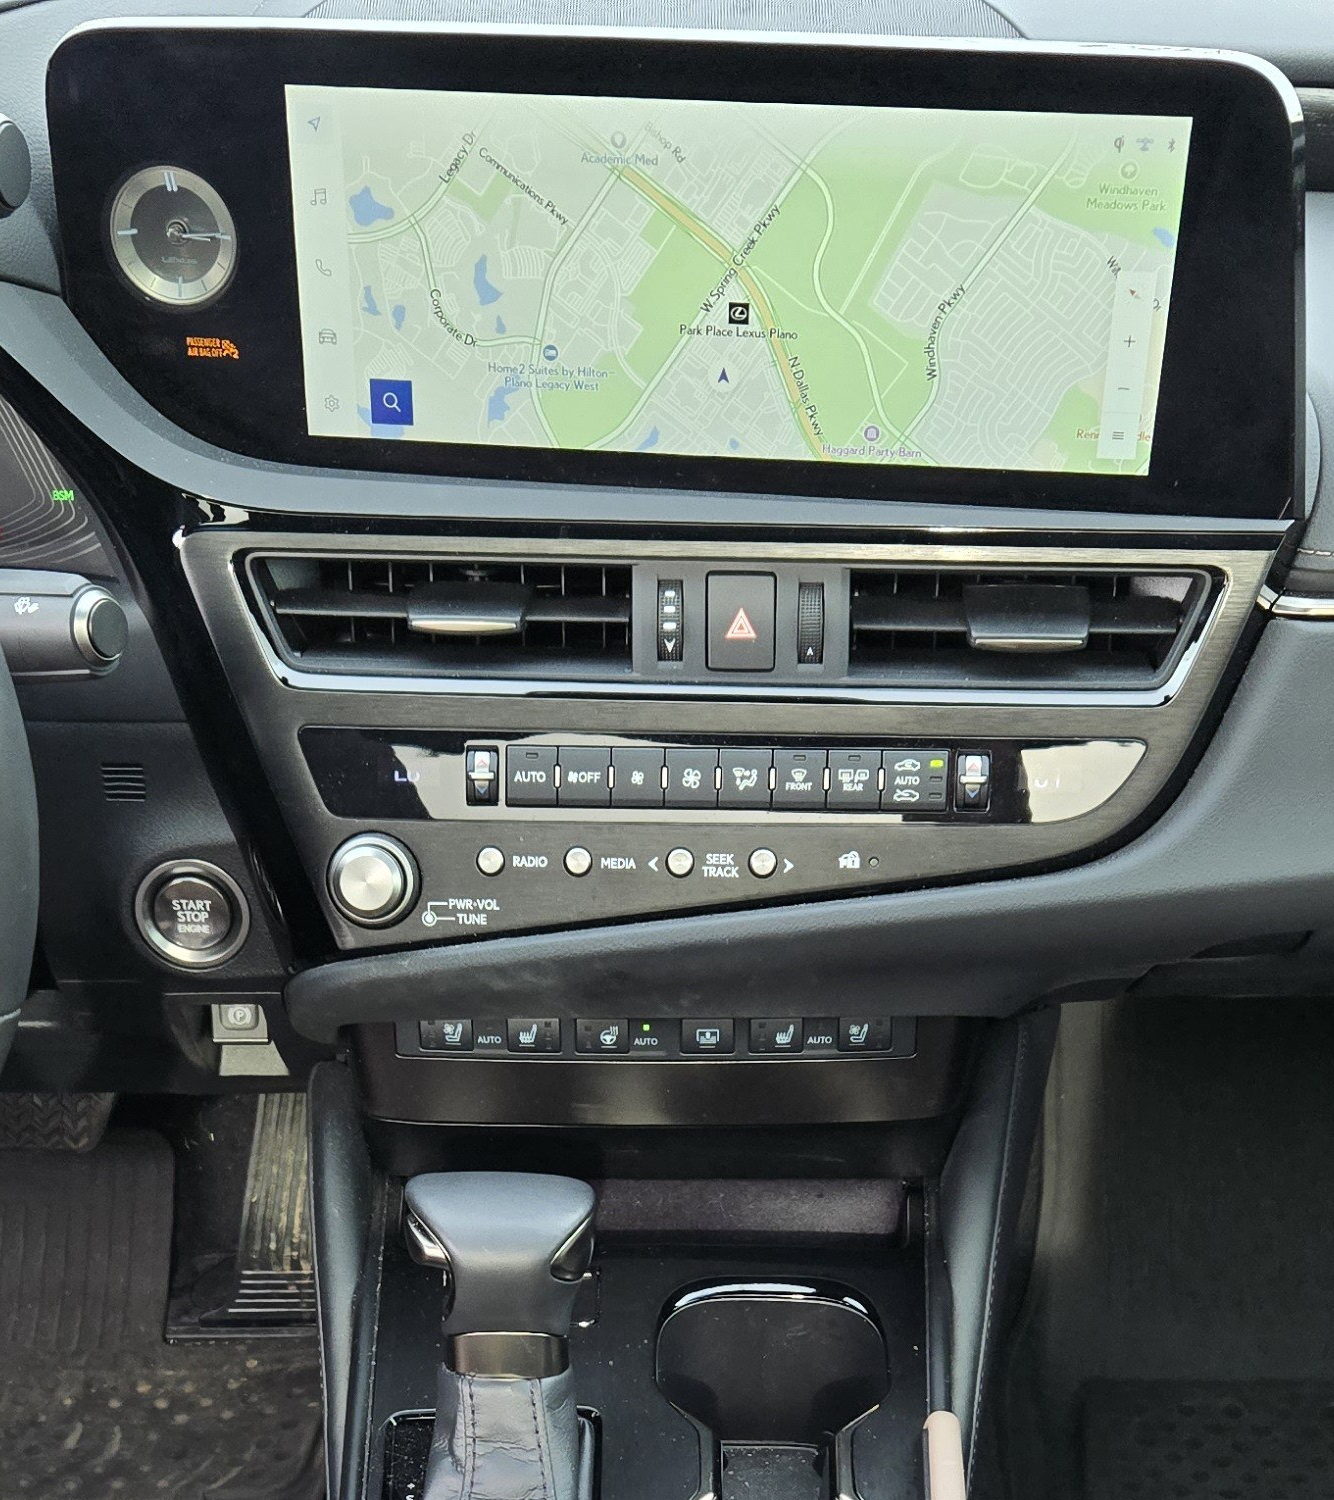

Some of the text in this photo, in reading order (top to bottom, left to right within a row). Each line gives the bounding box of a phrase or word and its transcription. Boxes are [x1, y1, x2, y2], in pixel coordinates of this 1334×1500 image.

[439, 130, 478, 184] Legacy Dr
[580, 152, 658, 166] Academic Med
[672, 146, 686, 163] Rd
[478, 147, 569, 226] Communications Pkwy
[1099, 184, 1158, 196] Windhaven
[1086, 198, 1166, 212] Meadows Park
[700, 204, 781, 313] W Spring Creek Pkwy
[429, 288, 464, 342] Corporate
[679, 325, 798, 340] Park Place Lexus Plano
[924, 284, 966, 381] Windhaven Pkwy
[488, 362, 526, 375] Home2
[528, 365, 558, 377] Suites
[562, 366, 574, 379] by
[504, 376, 599, 392] Plano Legacy West
[788, 356, 824, 437] N Dallas Pkwy
[822, 444, 921, 459] Haggard Party Barn
[52, 490, 75, 501] BSM
[514, 771, 546, 783] AUTO
[578, 771, 602, 783] OFF
[894, 775, 920, 786] AUTO
[785, 781, 812, 792] FRONT
[842, 781, 864, 792] REAR
[512, 856, 548, 868] RADIO
[601, 857, 636, 870] MEDIA
[706, 853, 734, 866] SEEK
[702, 866, 739, 878] TRACK
[172, 899, 212, 912] START
[177, 911, 209, 923] STOP
[457, 913, 487, 925] TUNE
[177, 924, 210, 935] ENGINE
[477, 1035, 502, 1044] AUTO
[634, 1036, 658, 1046] AUTO
[807, 1035, 832, 1044] AUTO
